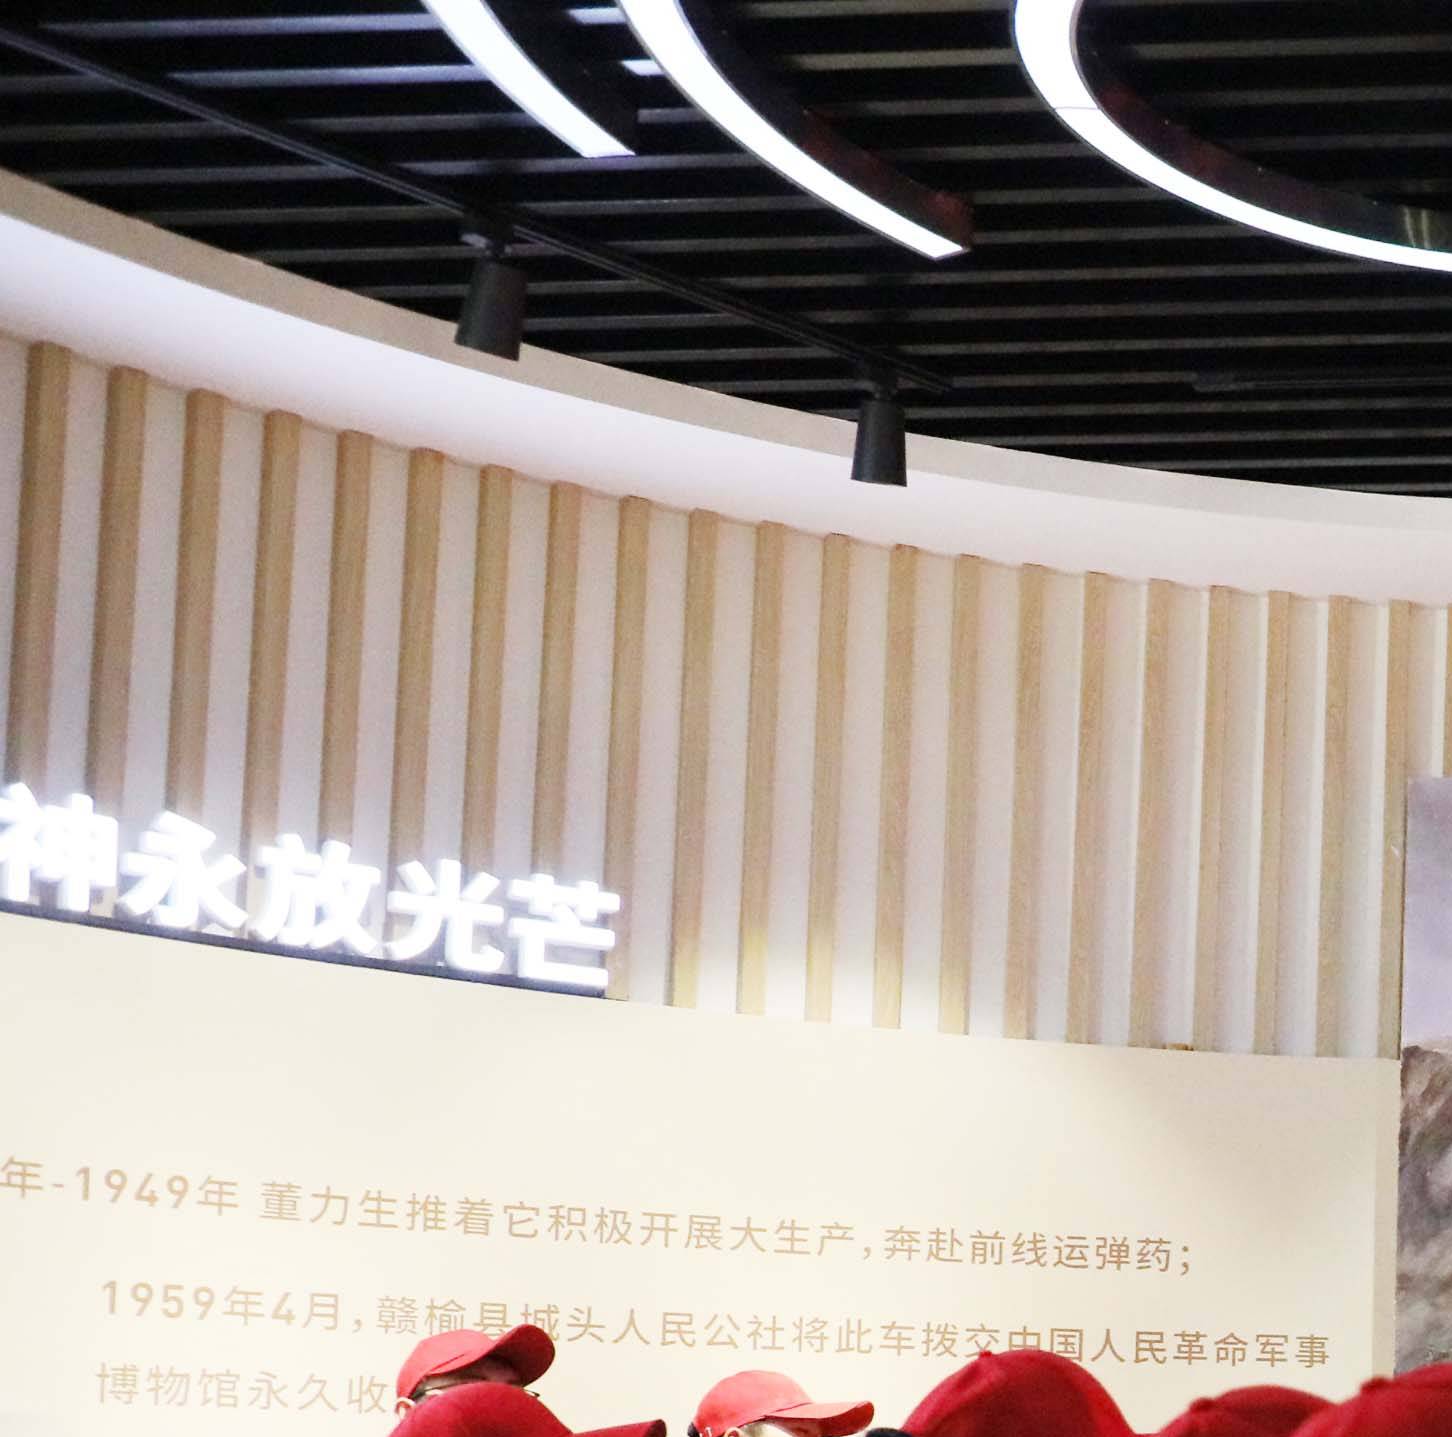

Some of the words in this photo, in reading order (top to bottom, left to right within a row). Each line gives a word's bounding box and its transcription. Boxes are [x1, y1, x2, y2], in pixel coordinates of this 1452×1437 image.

[0, 783, 621, 988] 神永放光芒
